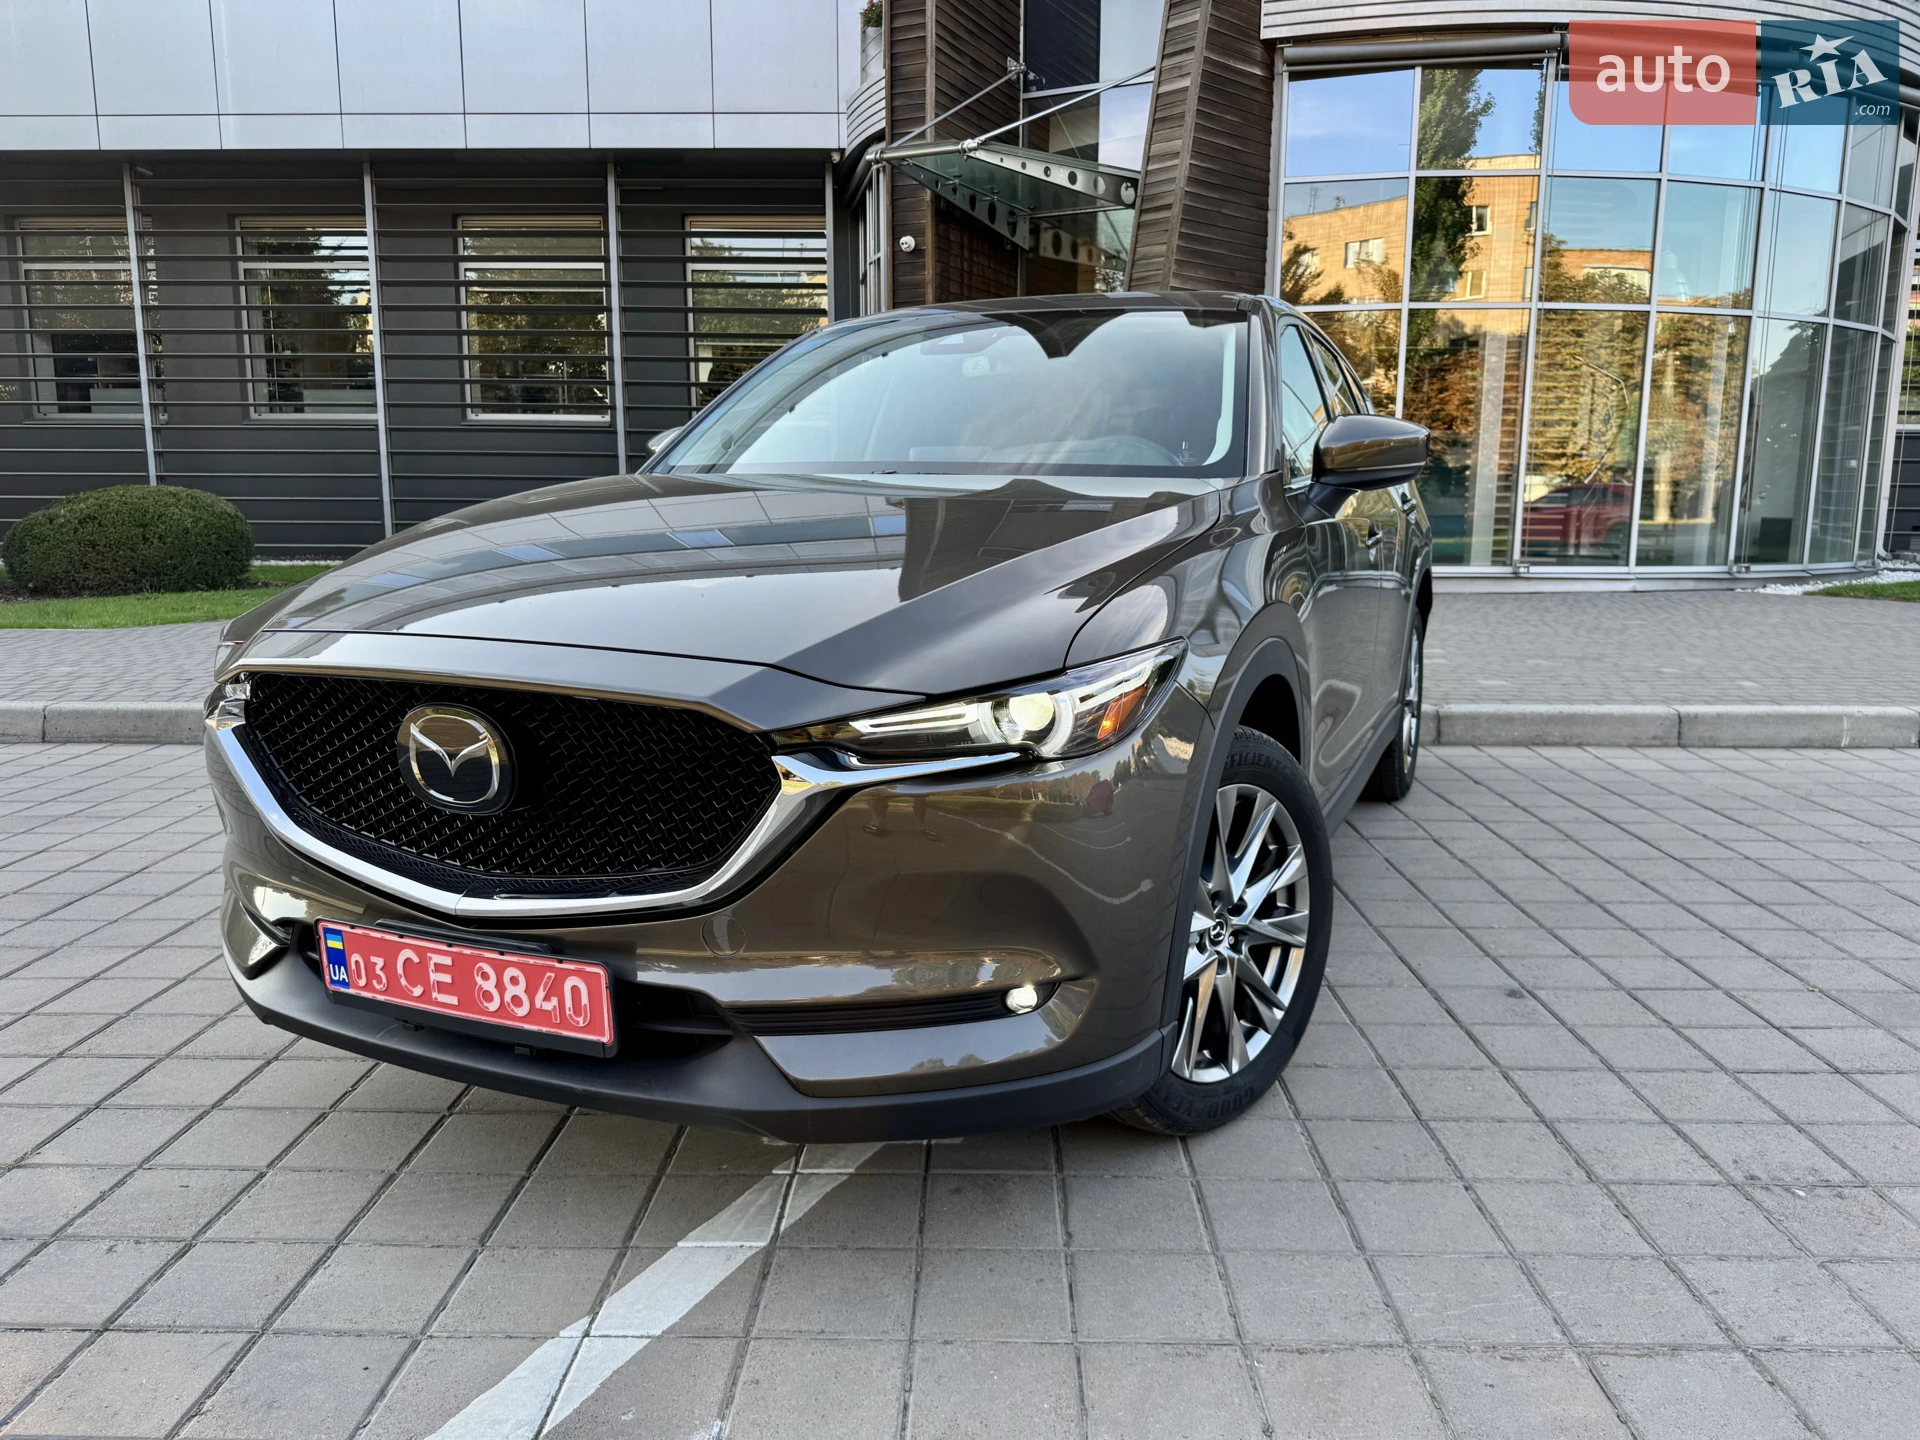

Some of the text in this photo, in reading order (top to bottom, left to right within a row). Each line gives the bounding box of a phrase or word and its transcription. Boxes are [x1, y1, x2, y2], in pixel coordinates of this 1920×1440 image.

[329, 964, 348, 982] UA
[351, 949, 591, 1028] 03 CE 8840
